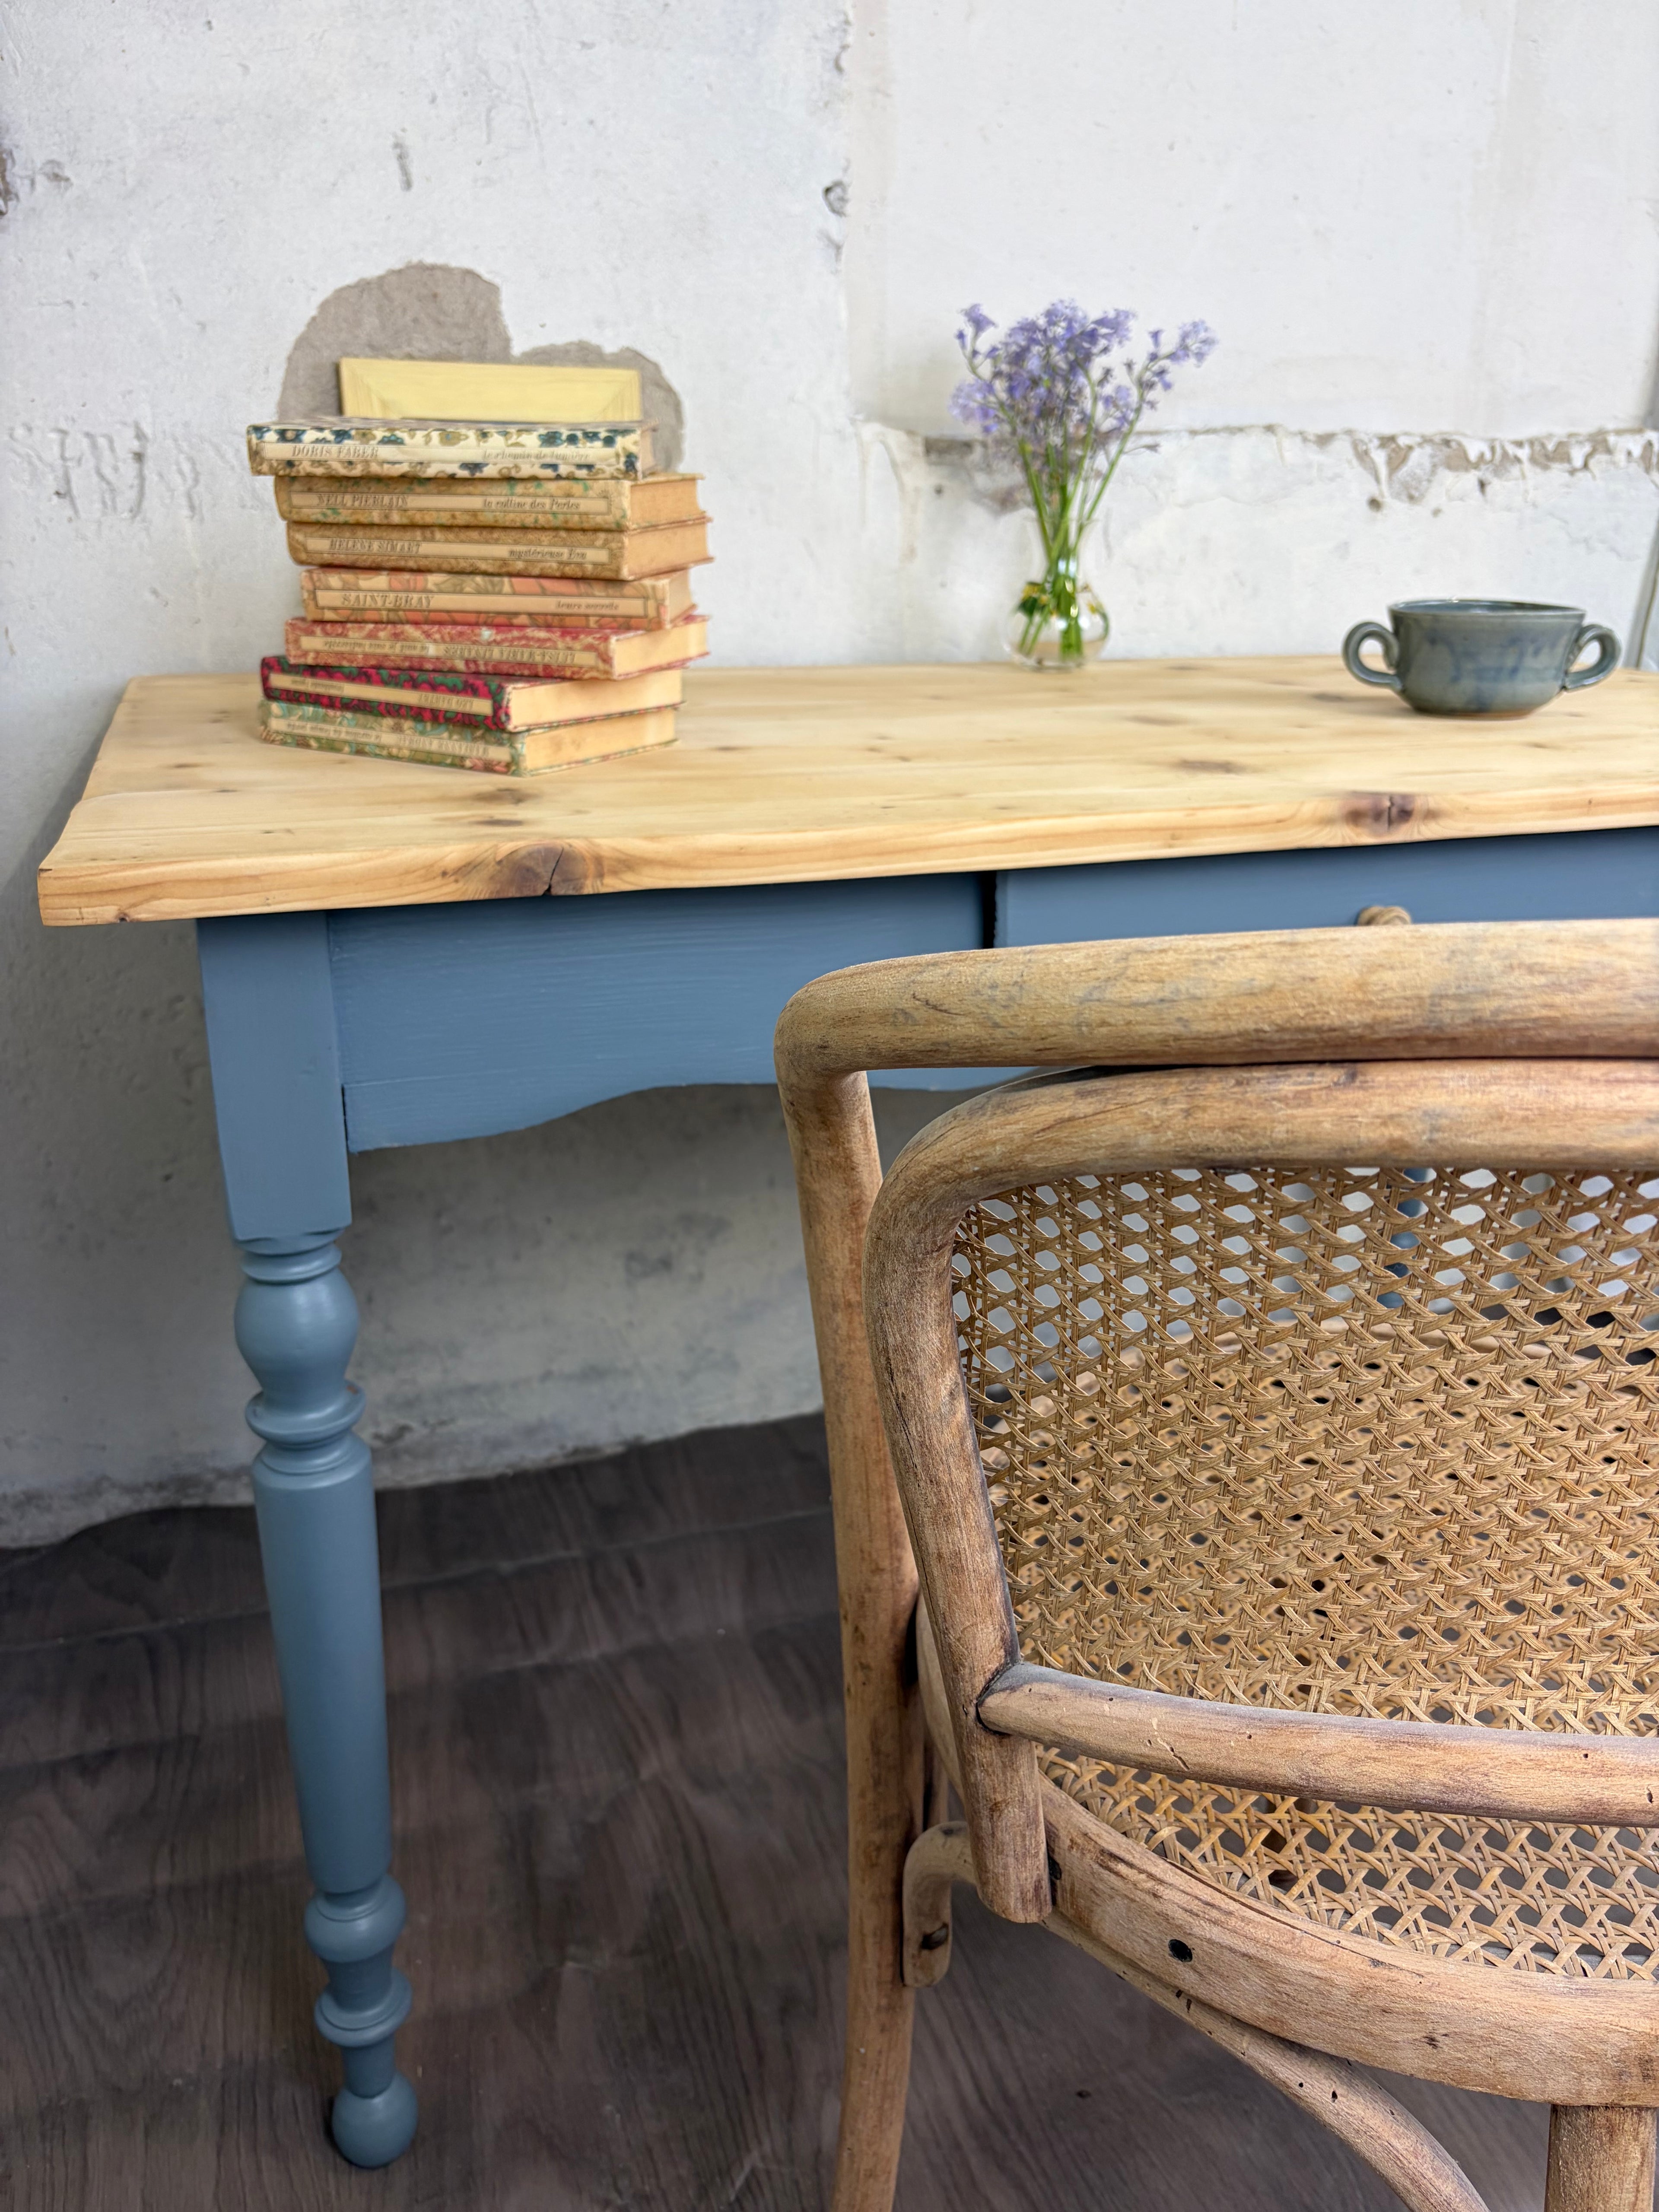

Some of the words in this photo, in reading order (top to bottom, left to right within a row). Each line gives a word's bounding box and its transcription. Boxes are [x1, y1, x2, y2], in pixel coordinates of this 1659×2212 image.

[291, 445, 332, 458] DORIS
[336, 446, 379, 459] FABER
[342, 592, 435, 609] SAINT-BRAY
